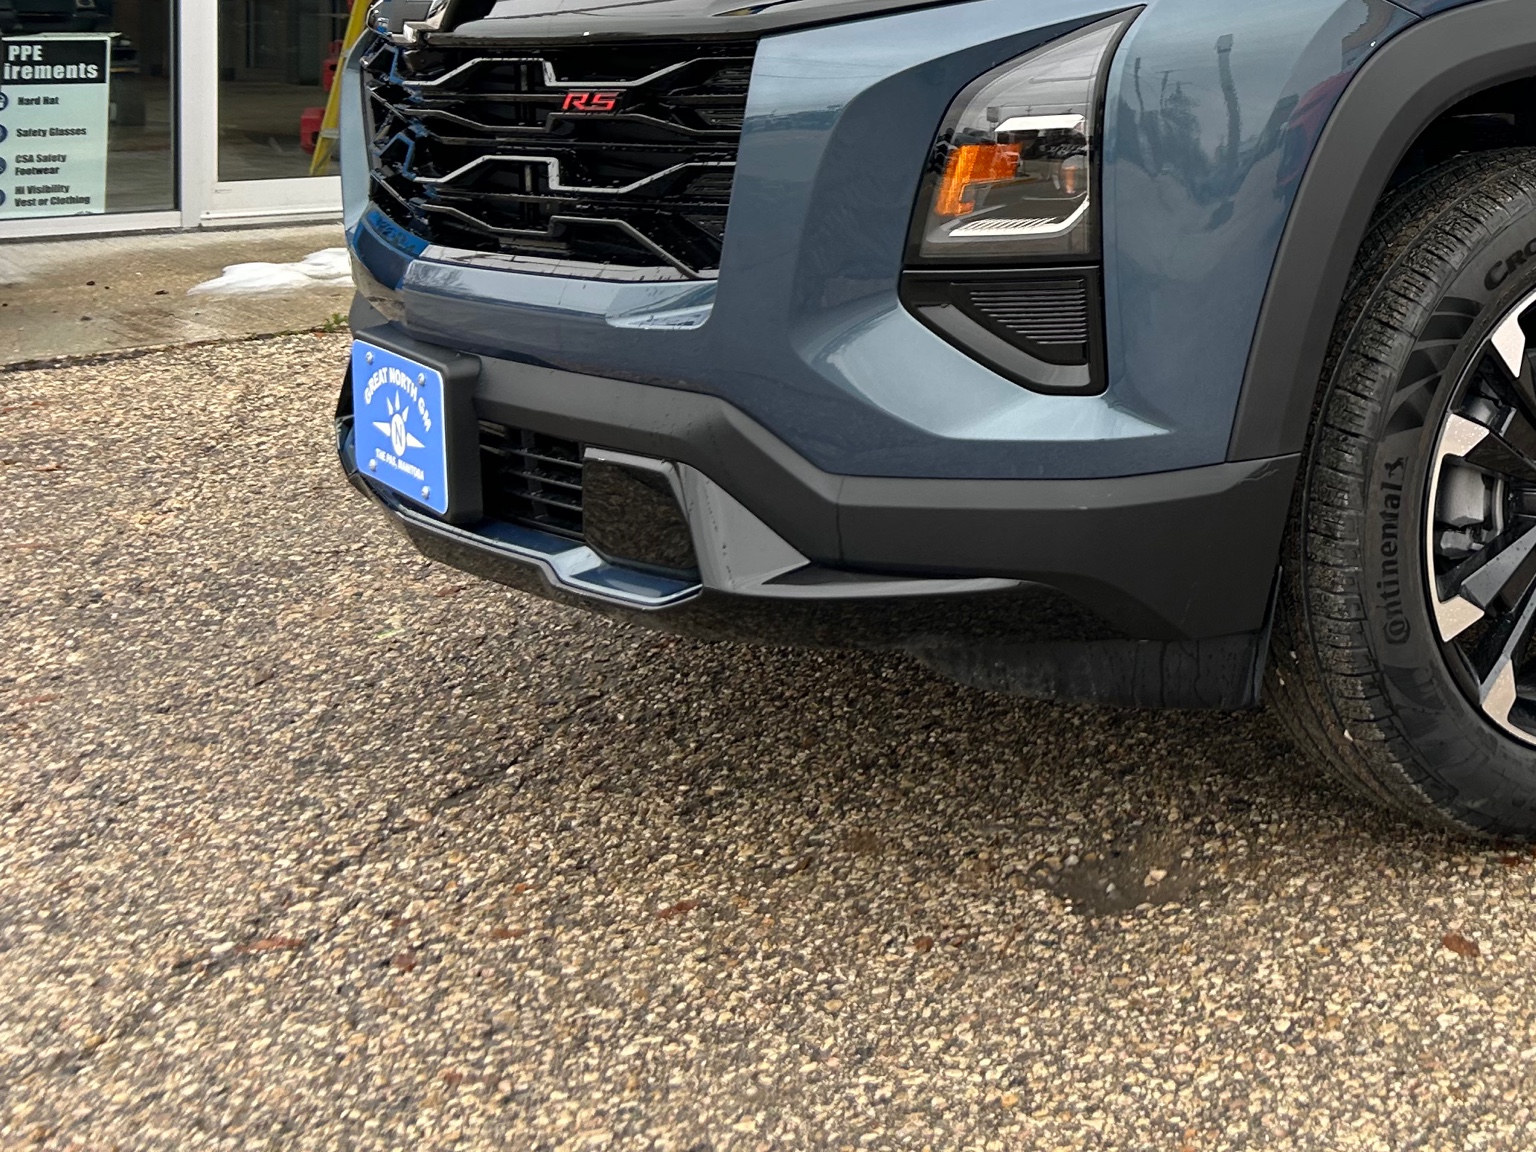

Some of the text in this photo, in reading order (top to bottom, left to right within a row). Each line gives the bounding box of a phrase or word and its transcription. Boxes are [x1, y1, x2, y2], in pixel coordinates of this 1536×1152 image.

[8, 45, 43, 61] PPE
[17, 97, 59, 105] Hard Hat
[562, 92, 620, 110] RS
[16, 128, 87, 137] Safety Glasses
[15, 154, 67, 163] CSA Safety
[15, 167, 60, 176] Footwear
[27, 184, 70, 194] Visibility
[15, 196, 91, 207] Vest or Clothing
[364, 367, 388, 405] GREAT
[389, 367, 418, 402] NORTH
[375, 448, 386, 462] THE
[398, 458, 425, 481] MANITOBA
[1376, 482, 1411, 645] Continental
